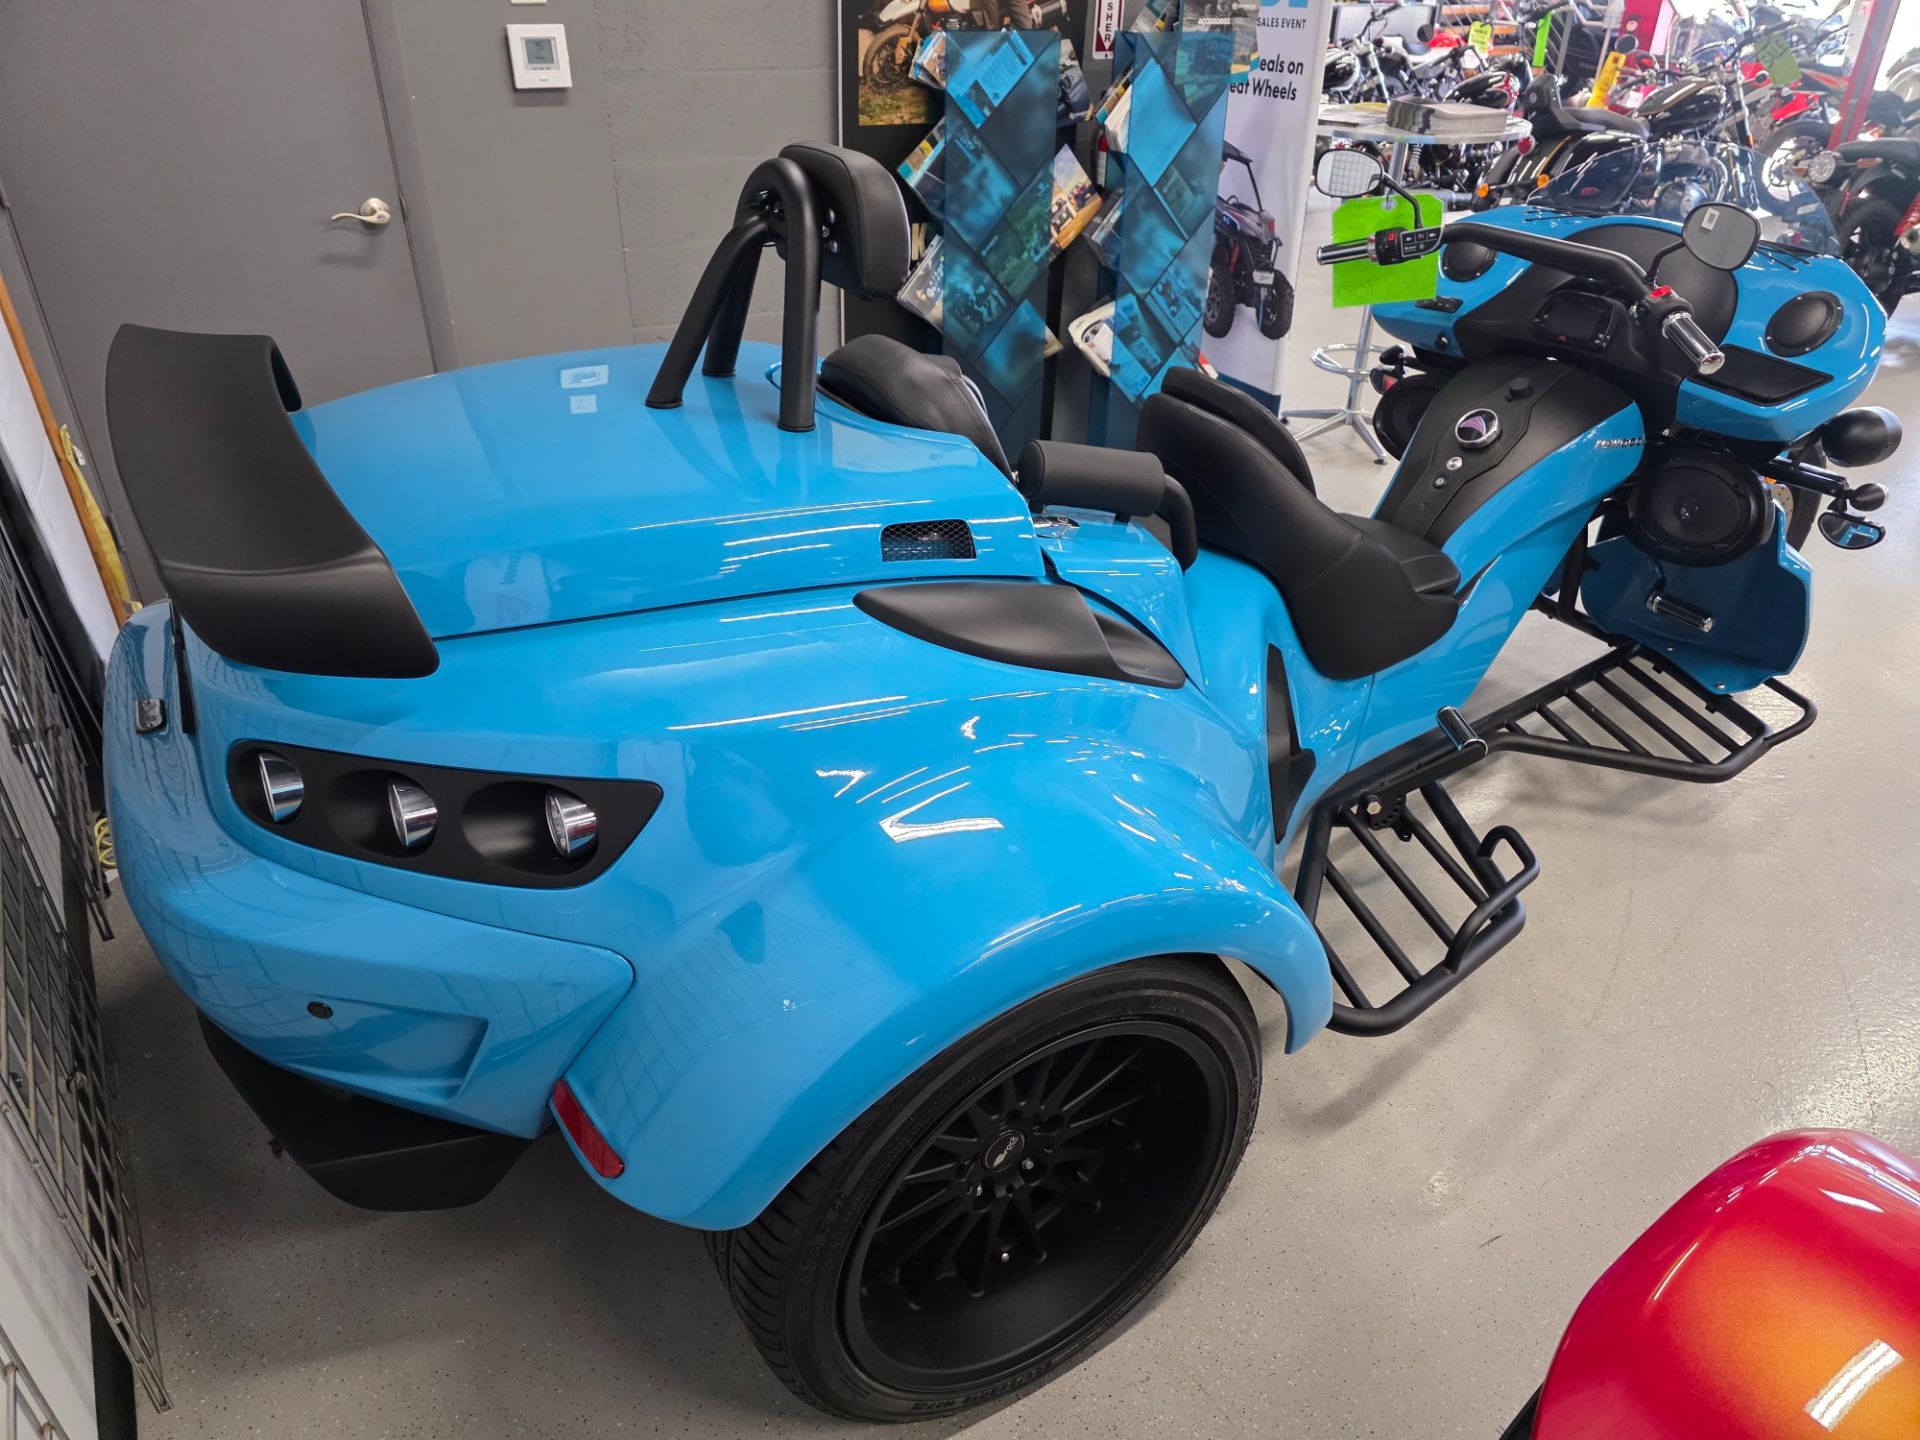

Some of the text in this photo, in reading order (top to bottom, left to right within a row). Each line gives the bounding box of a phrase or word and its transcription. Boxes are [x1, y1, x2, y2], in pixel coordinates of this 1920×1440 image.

[1256, 16, 1307, 30] SALES EVENT
[1287, 61, 1304, 75] on
[1252, 78, 1297, 101] Wheels
